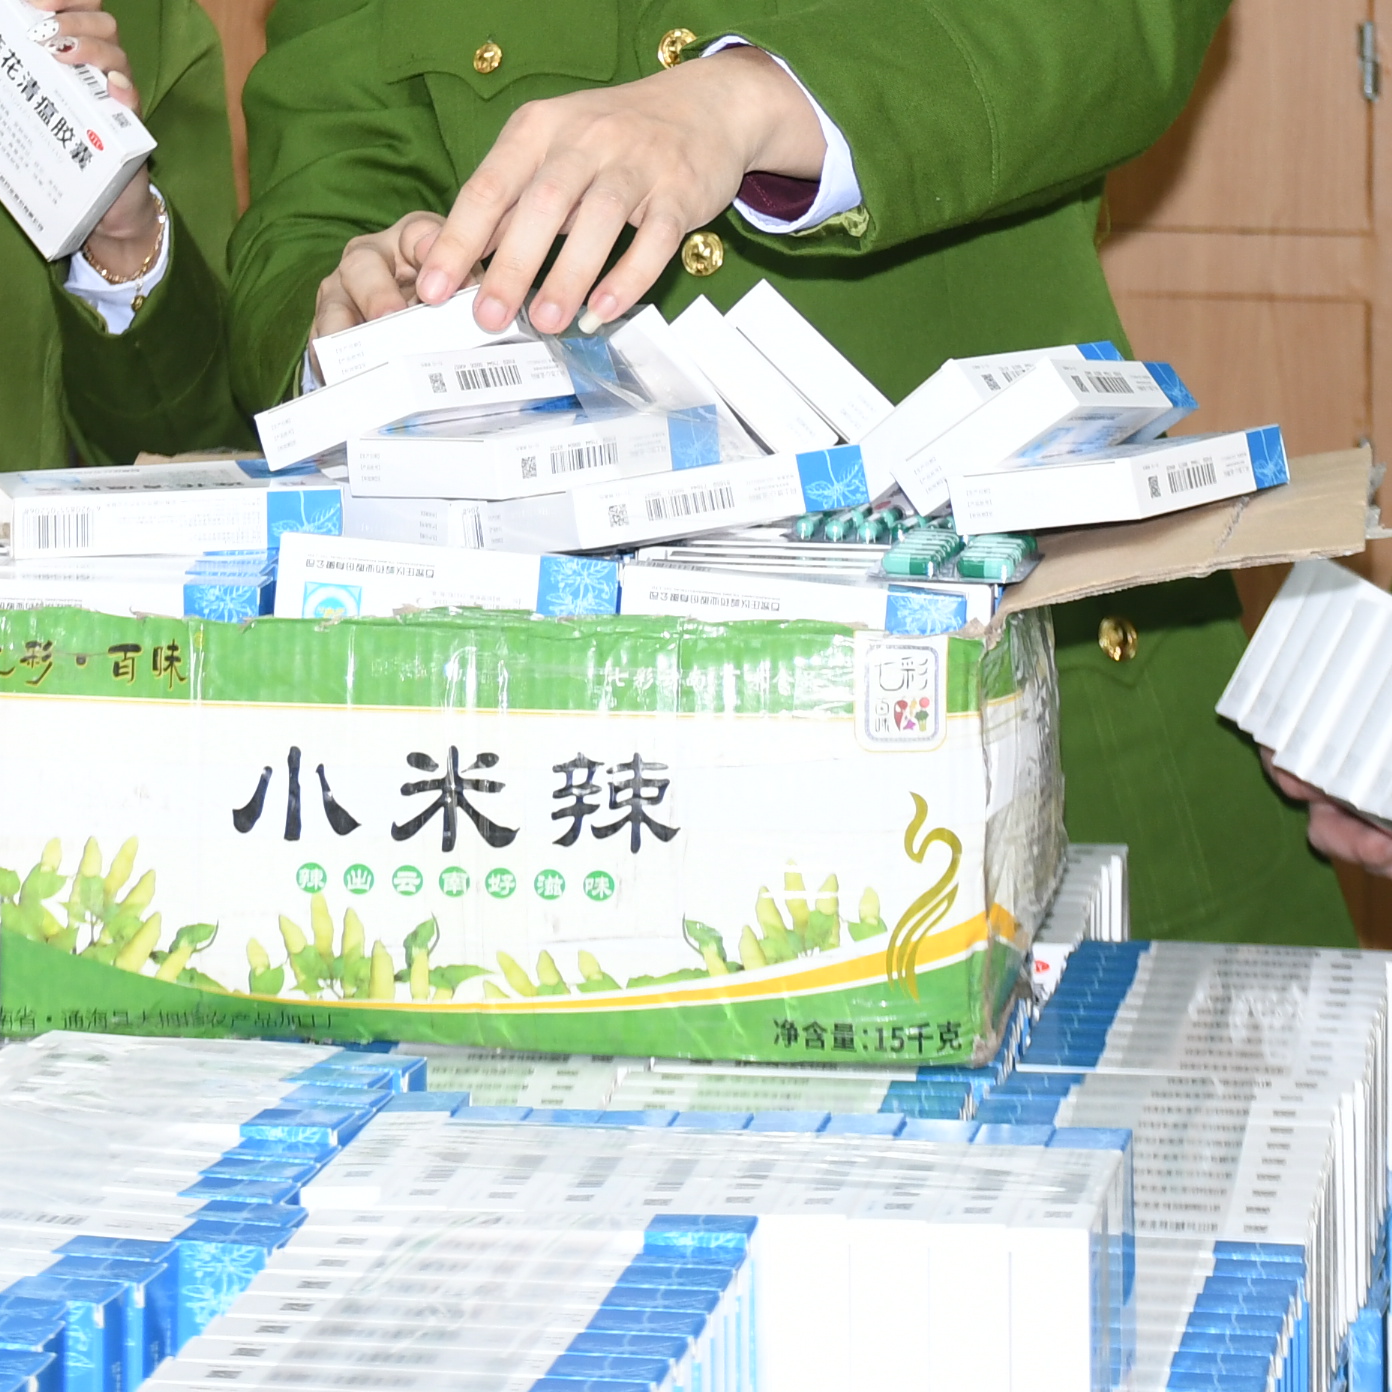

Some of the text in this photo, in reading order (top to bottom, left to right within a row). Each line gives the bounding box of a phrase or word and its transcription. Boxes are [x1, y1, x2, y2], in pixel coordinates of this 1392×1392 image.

[232, 745, 681, 854] 小米辣
[297, 865, 614, 900] 辣出云南好滋味
